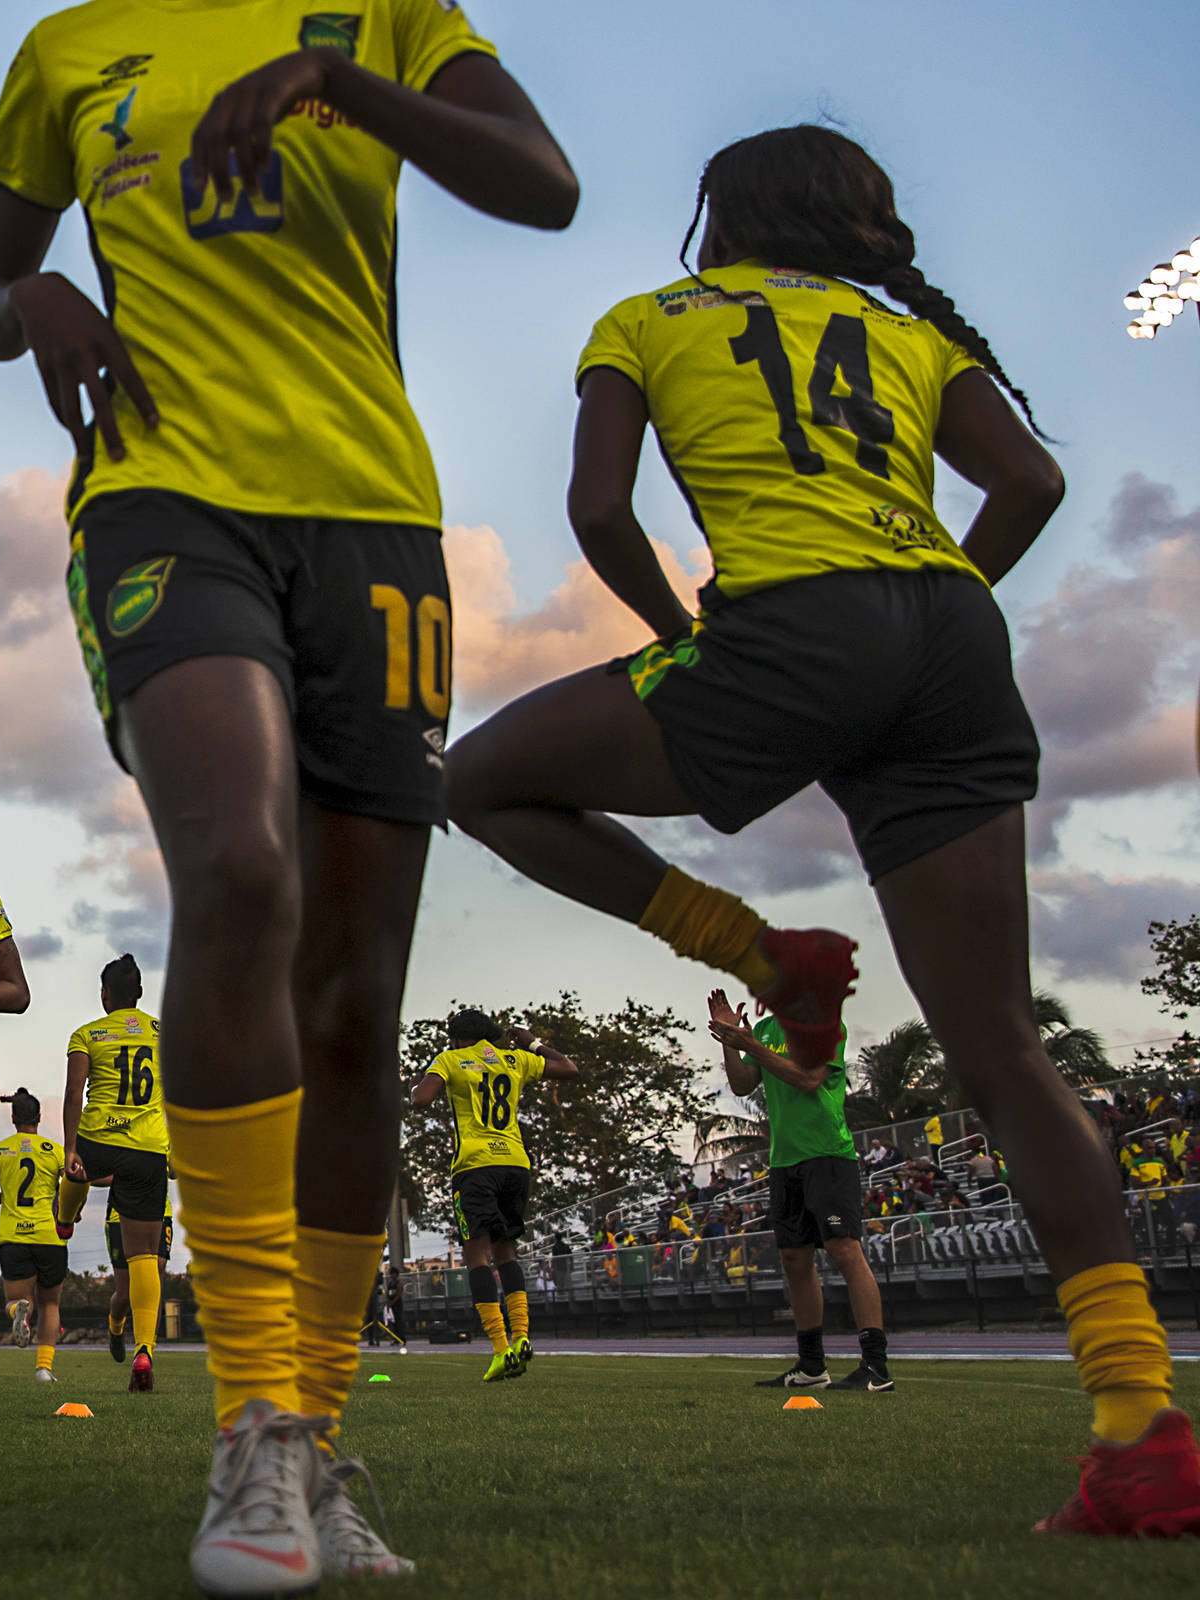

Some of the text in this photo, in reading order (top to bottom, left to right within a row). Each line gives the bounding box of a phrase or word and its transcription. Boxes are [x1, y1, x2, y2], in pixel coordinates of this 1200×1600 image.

[728, 304, 896, 480] 14
[369, 584, 450, 720] 10
[114, 1045, 154, 1106] 16
[478, 1072, 511, 1131] 18
[17, 1157, 36, 1207] 2
[165, 1226, 172, 1244] 9
